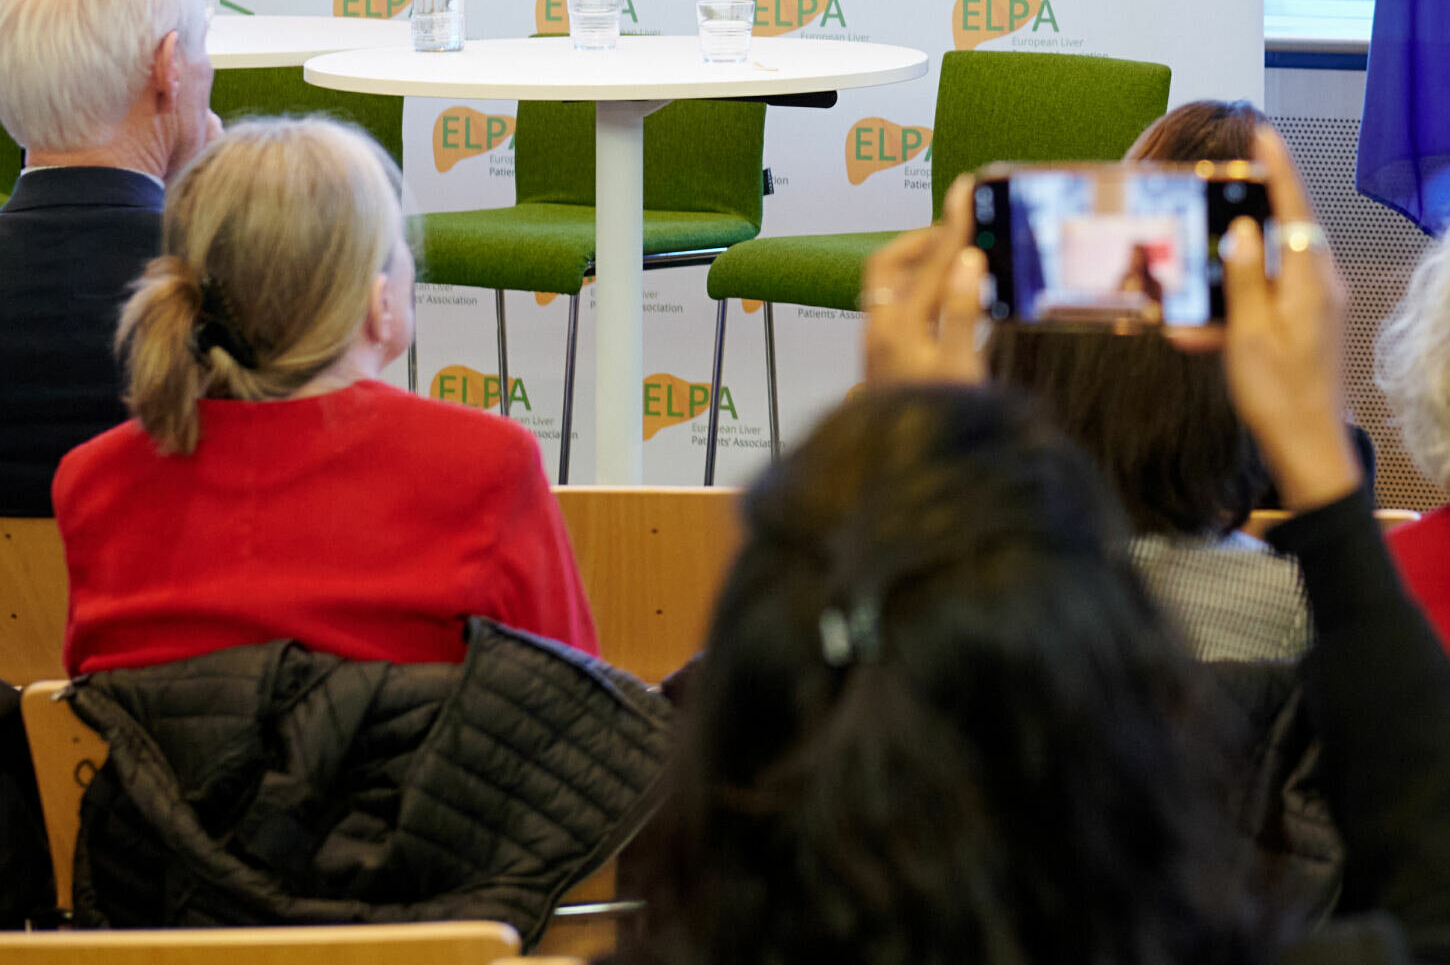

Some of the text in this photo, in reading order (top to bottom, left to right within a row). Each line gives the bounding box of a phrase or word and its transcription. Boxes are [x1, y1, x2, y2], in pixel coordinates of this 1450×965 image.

[1012, 37, 1084, 49] European Liver
[441, 115, 515, 150] ELP
[855, 127, 932, 162] ELP
[643, 383, 738, 420] ELPA
[740, 425, 761, 435] Liver
